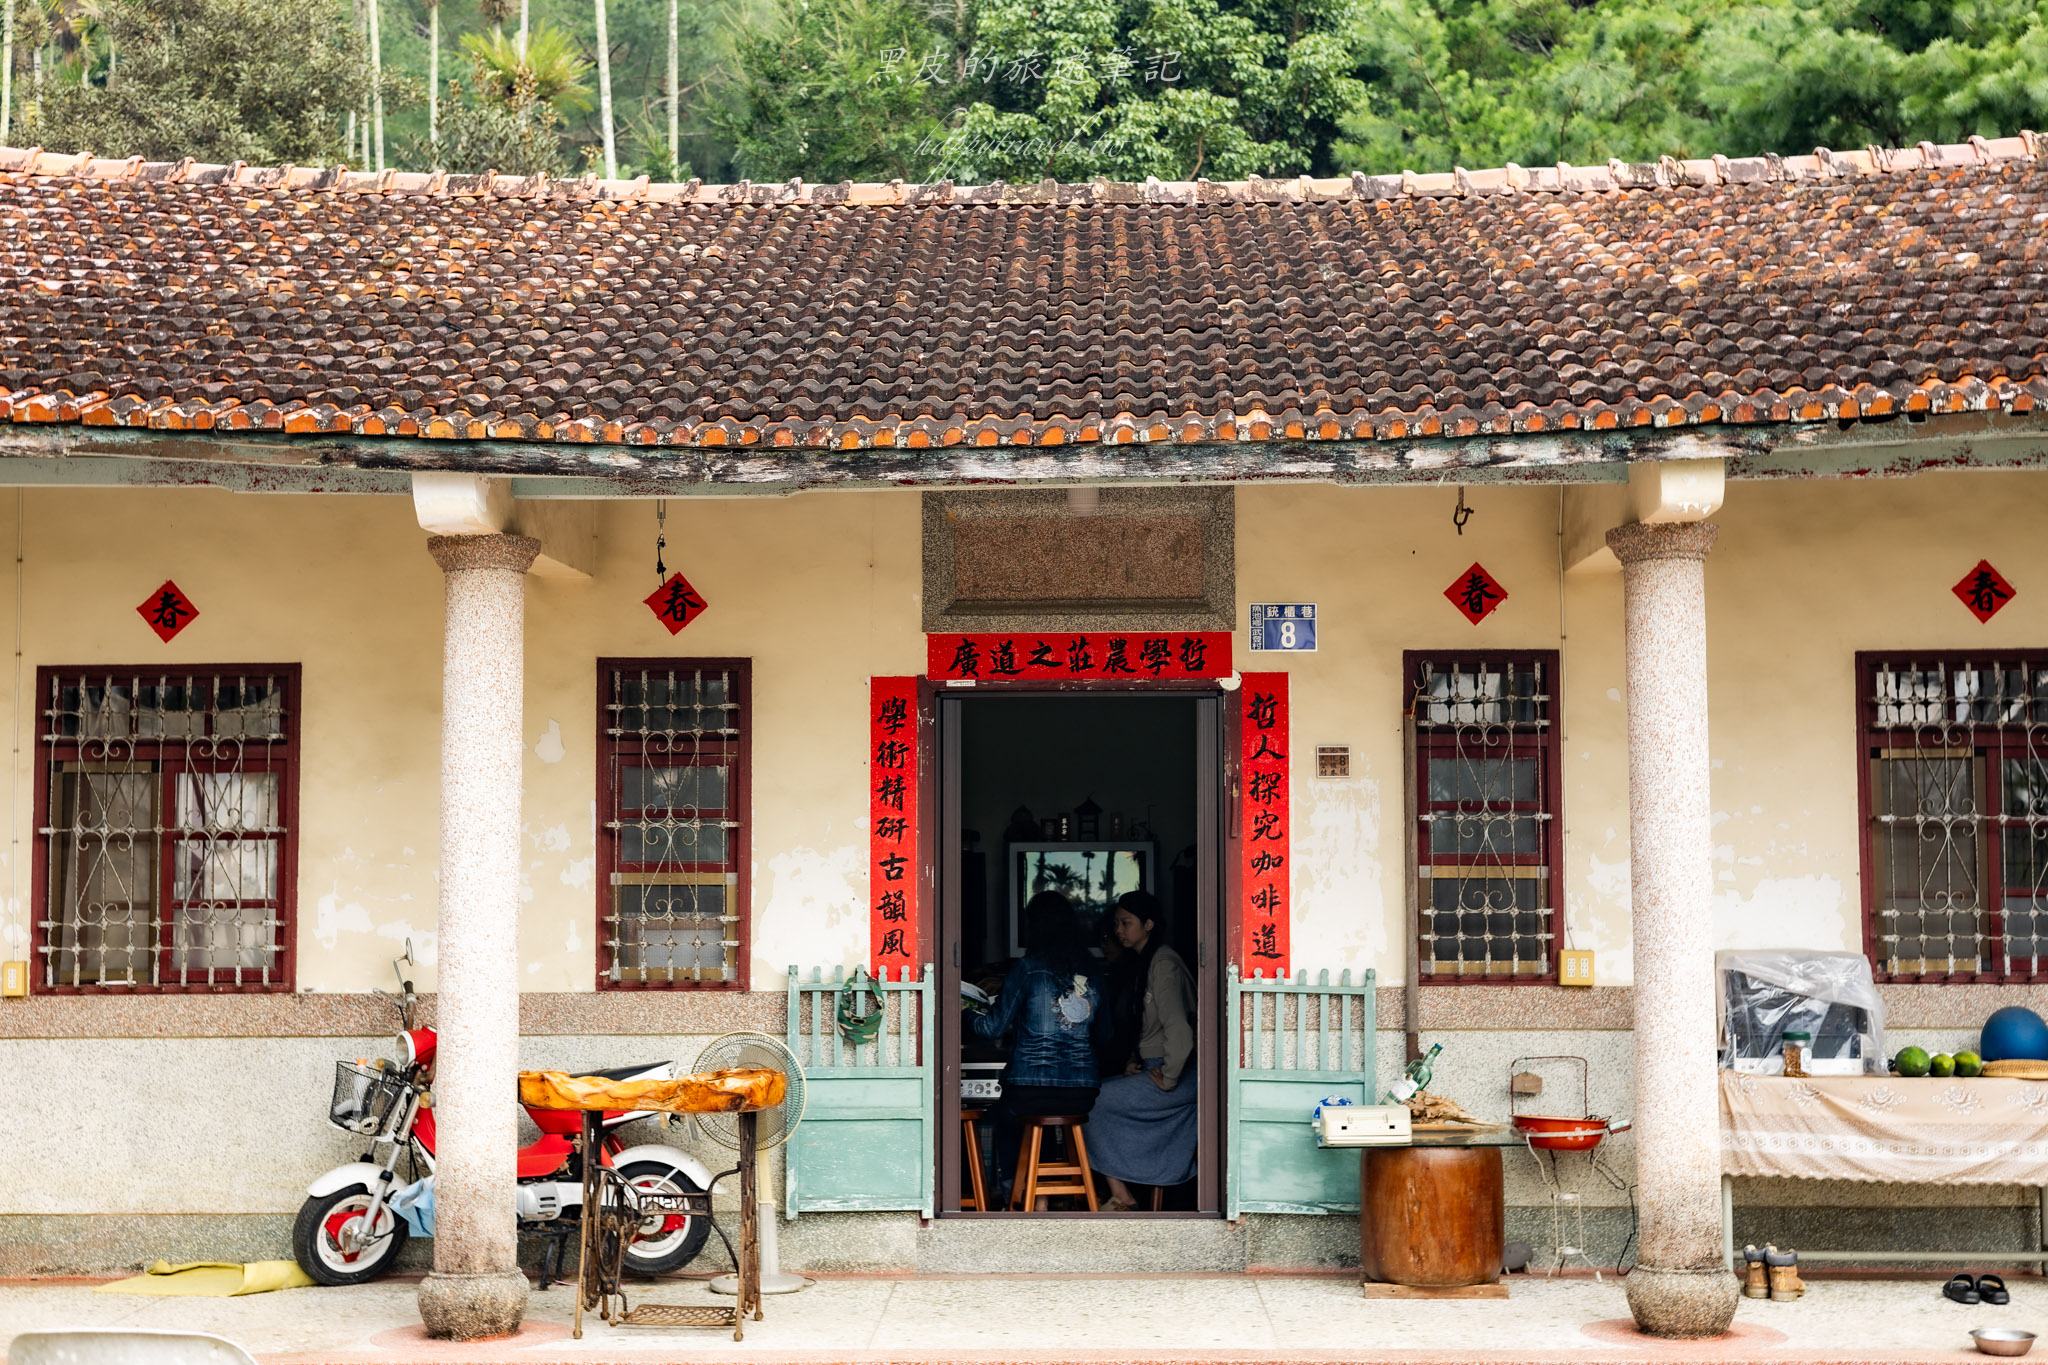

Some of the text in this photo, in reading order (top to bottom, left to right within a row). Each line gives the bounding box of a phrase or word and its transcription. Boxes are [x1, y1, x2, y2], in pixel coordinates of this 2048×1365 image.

[152, 591, 189, 630] 春
[662, 580, 702, 623] 春
[1460, 572, 1499, 615] 春
[1967, 571, 2008, 612] 春
[1281, 621, 1296, 649] 8
[1246, 691, 1286, 959] 哲人探究咖啡道
